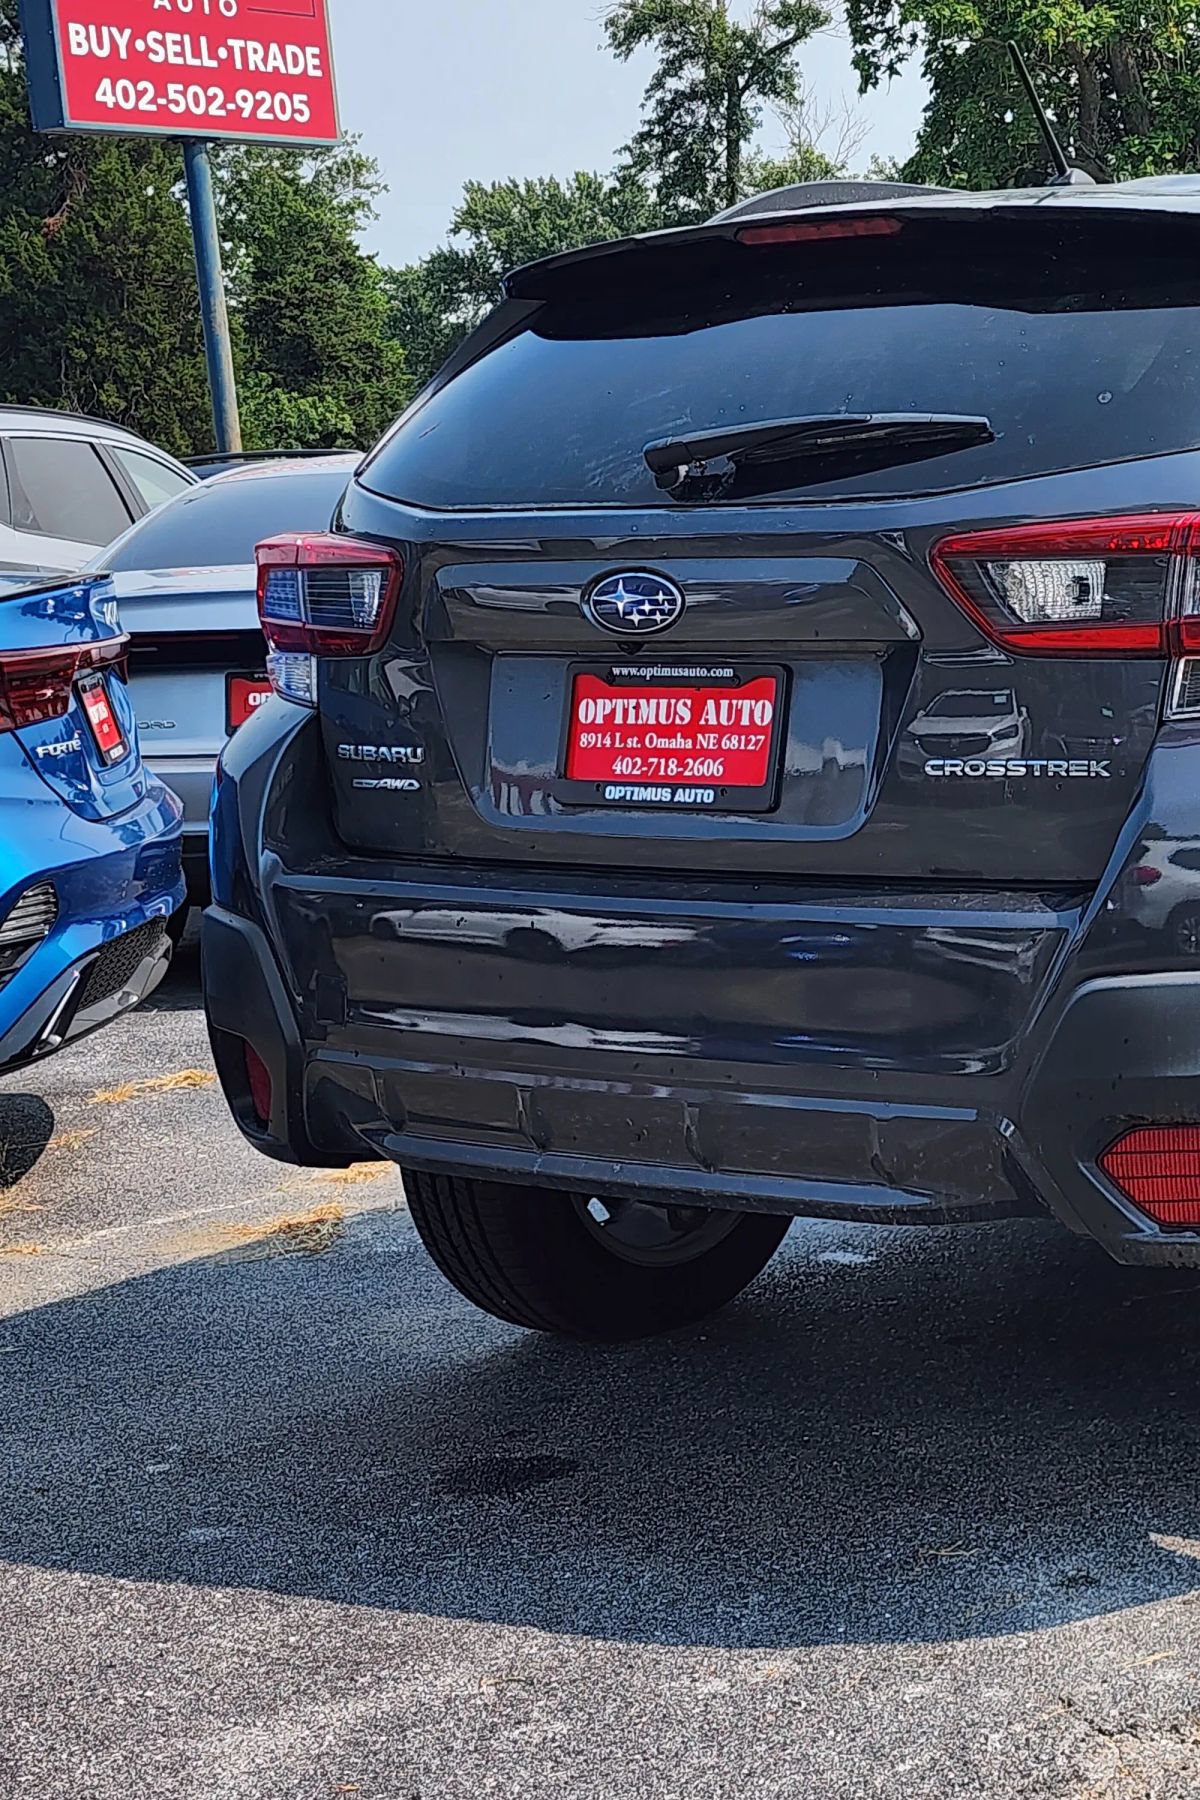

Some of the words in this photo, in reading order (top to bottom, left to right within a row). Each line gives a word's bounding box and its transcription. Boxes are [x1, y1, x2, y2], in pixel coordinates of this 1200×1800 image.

[153, 0, 238, 17] AUTO
[94, 77, 311, 123] 402-502-9205
[611, 665, 734, 680] www.optimusauto.com
[578, 698, 692, 724] OPTIMUS
[698, 699, 773, 726] AUTO
[579, 732, 612, 748] 8914
[614, 734, 625, 748] L
[626, 736, 642, 749] st.
[644, 733, 693, 749] Omaha
[695, 734, 719, 749] NE
[721, 735, 765, 751] 68127
[337, 744, 425, 763] SUBARU
[611, 756, 724, 777] 402-718-2606
[924, 759, 1112, 777] CROSSTREK
[376, 778, 421, 790] AWD
[604, 785, 672, 801] OPTIMUS
[673, 787, 715, 803] AUTO
